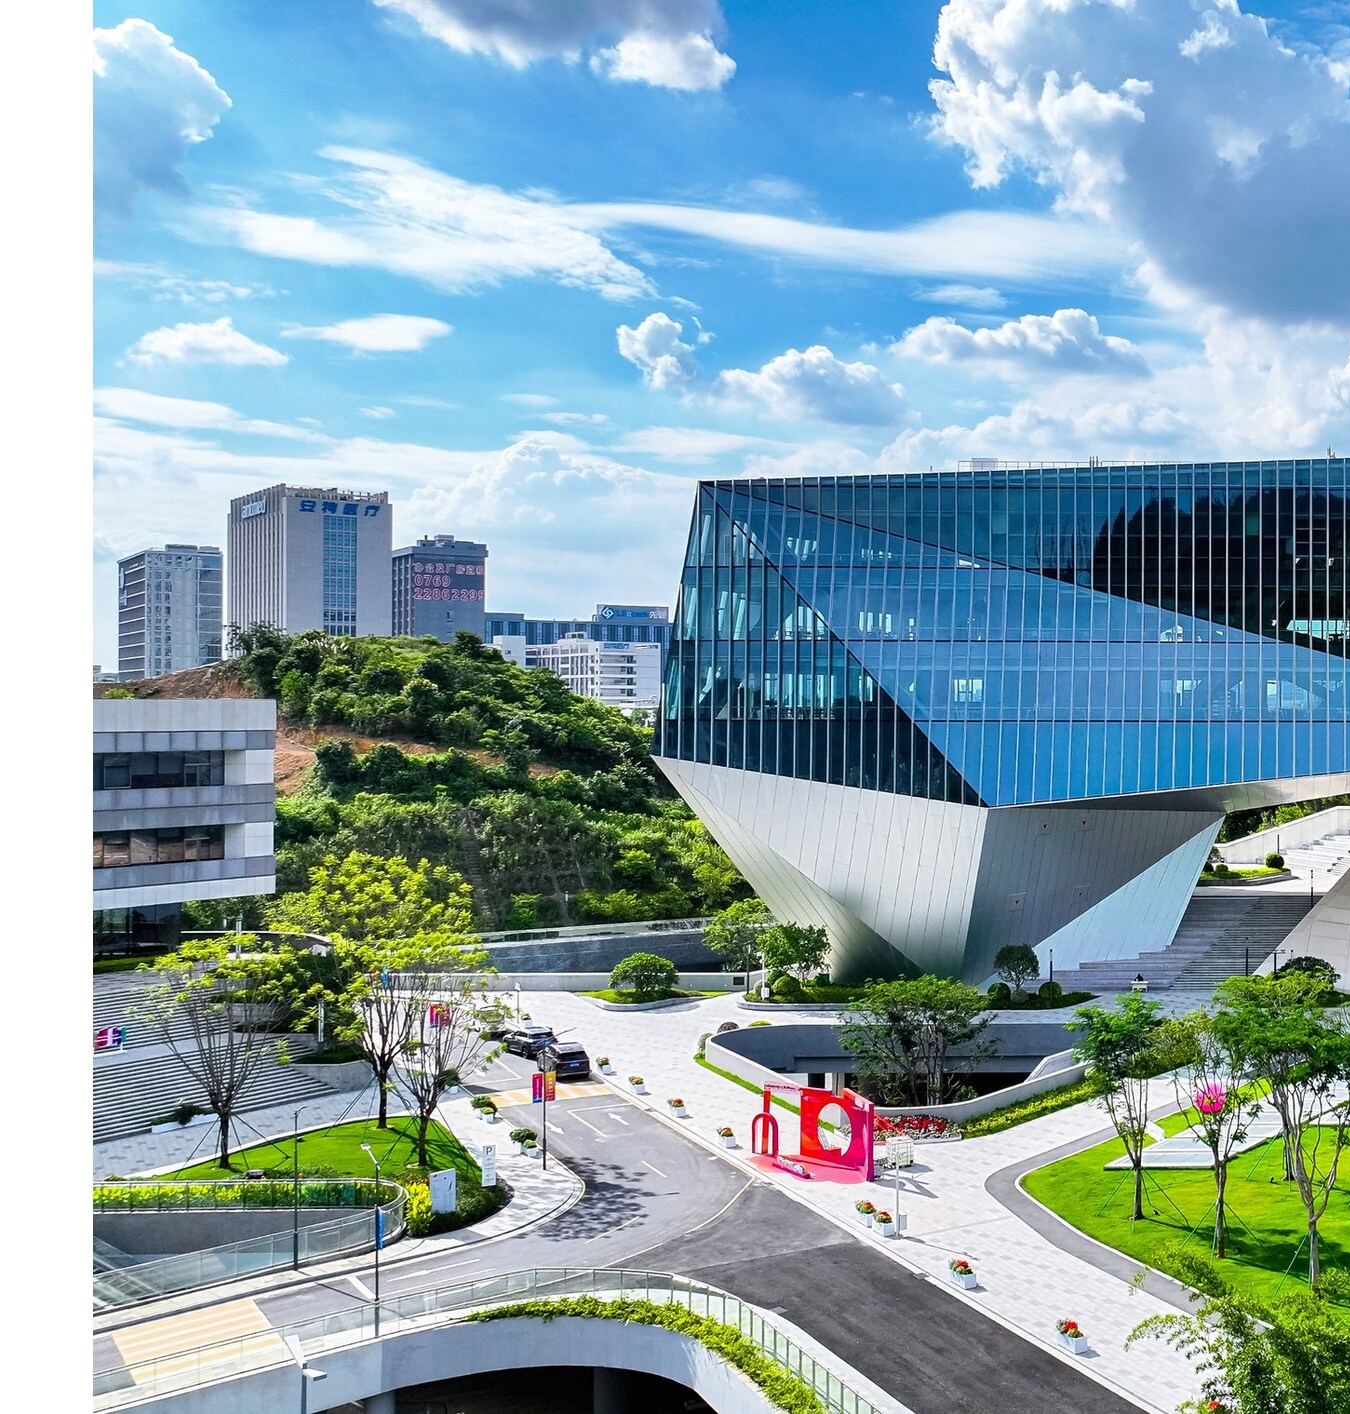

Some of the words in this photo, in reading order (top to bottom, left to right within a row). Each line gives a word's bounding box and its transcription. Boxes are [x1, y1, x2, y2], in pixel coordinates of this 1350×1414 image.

[414, 573, 451, 588] 0769
[414, 588, 485, 601] 22862299
[486, 1146, 493, 1155] P
